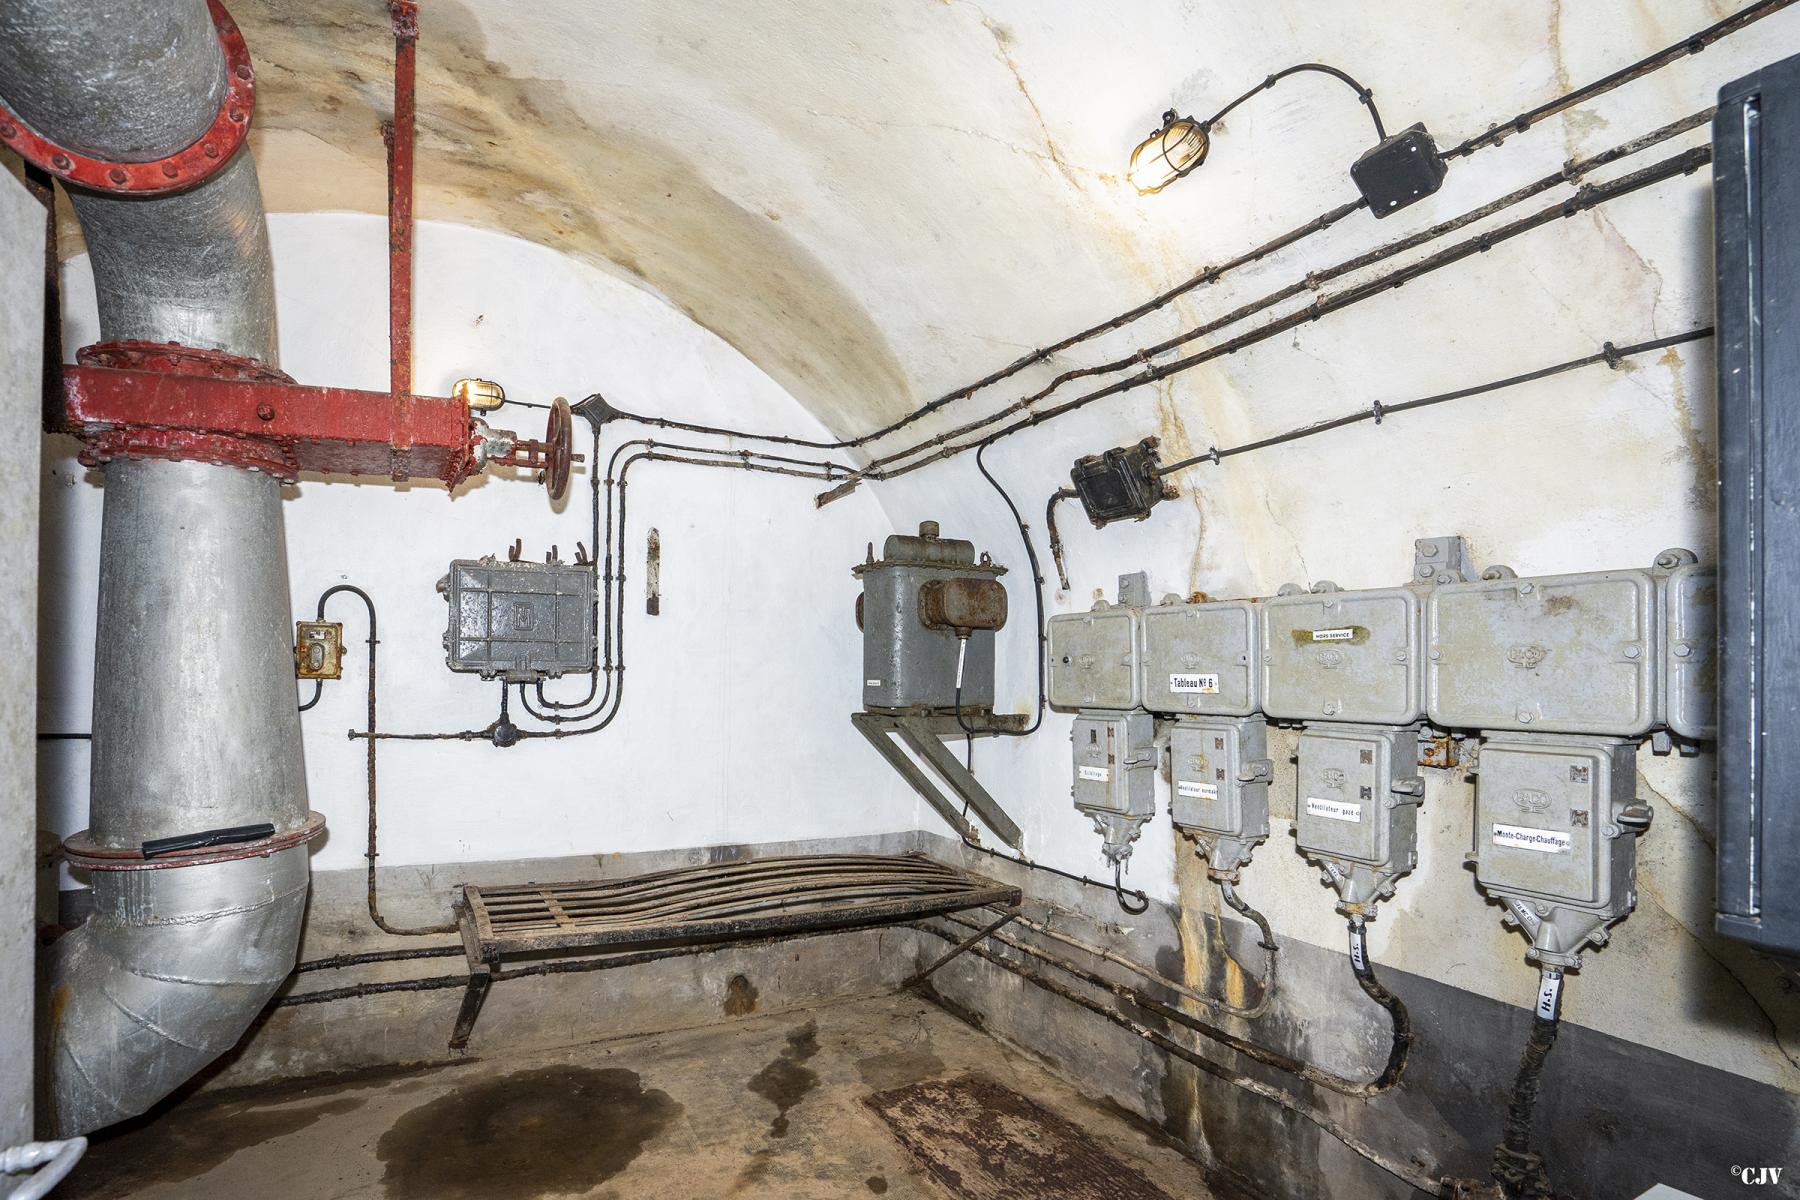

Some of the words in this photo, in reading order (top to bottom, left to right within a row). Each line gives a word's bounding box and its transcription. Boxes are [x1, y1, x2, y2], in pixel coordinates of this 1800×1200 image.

[1173, 677, 1198, 688] Tableau
[1208, 678, 1213, 688] 6
[1541, 988, 1553, 1012] H.S.
